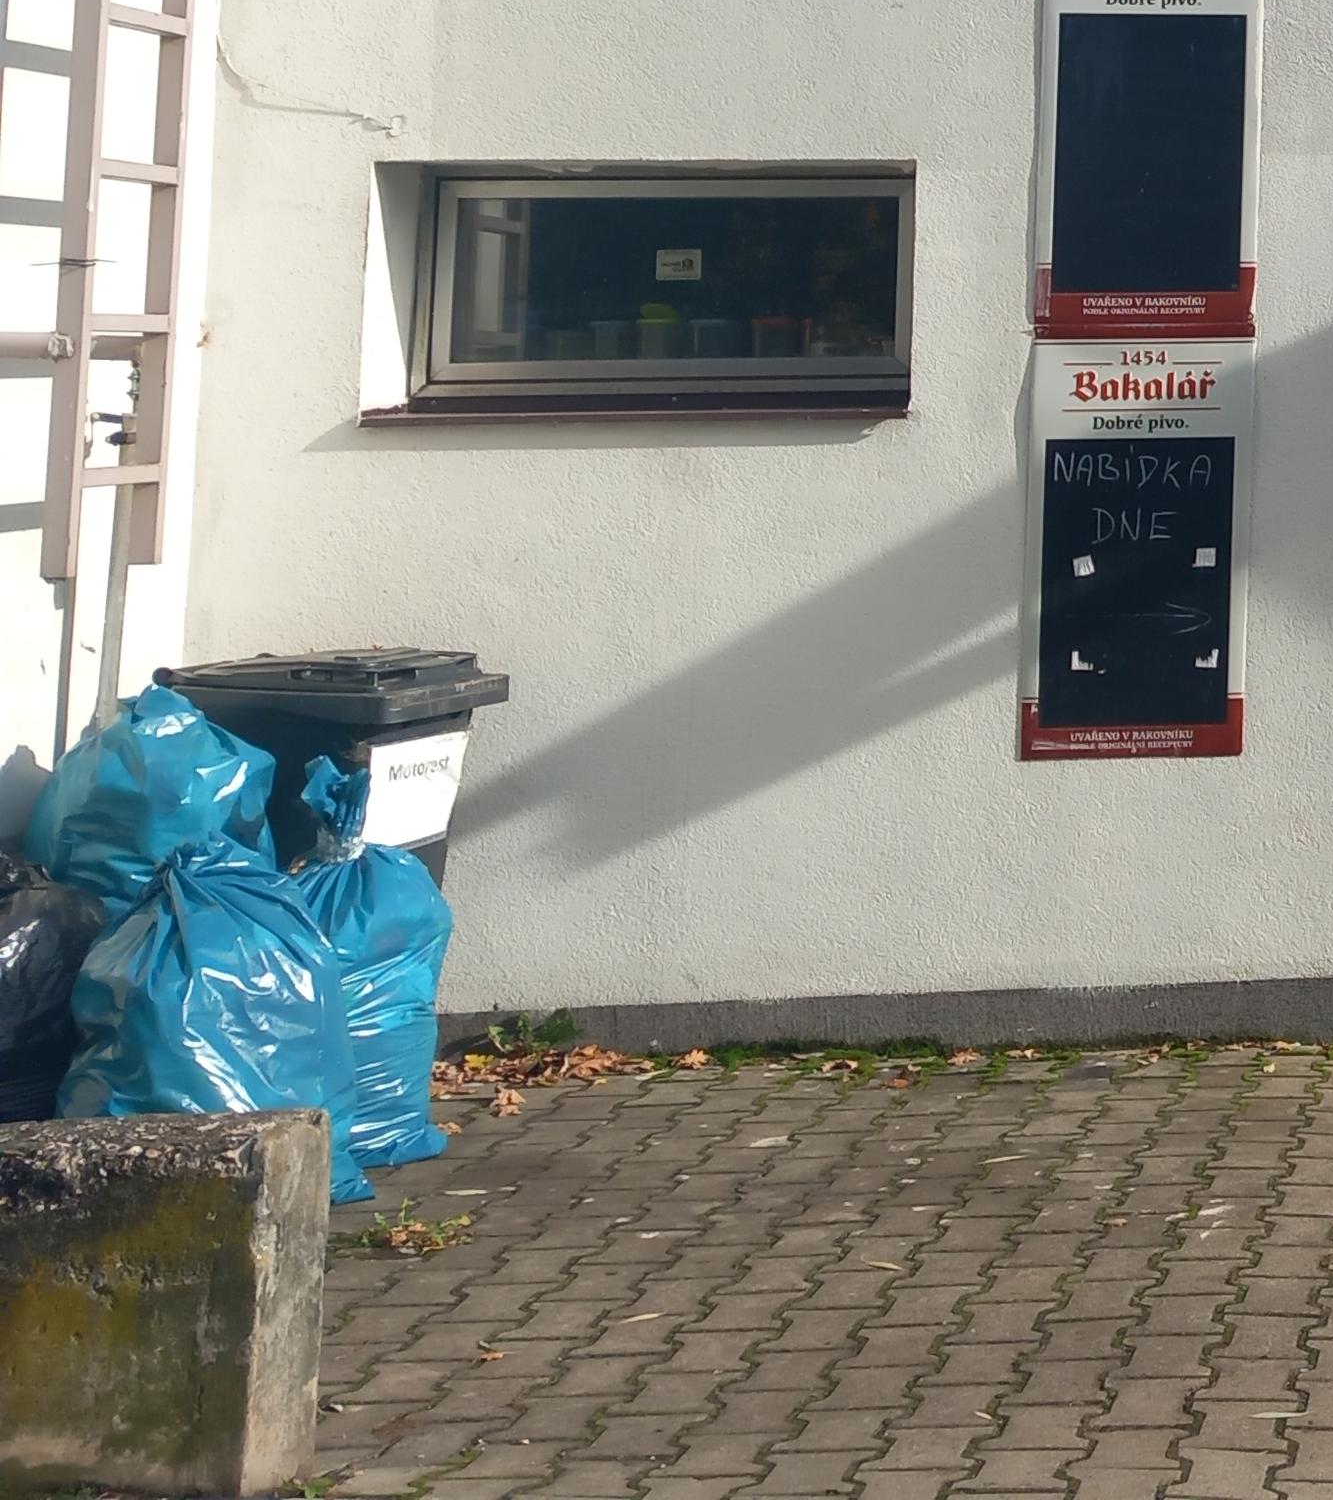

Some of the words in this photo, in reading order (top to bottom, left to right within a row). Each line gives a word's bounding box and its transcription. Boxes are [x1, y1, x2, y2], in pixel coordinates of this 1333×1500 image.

[1120, 350, 1167, 366] 1454
[1069, 370, 1217, 403] Bakalář
[1092, 414, 1144, 430] Dobré
[1148, 415, 1190, 433] pivo.
[1052, 444, 1213, 491] NABÍDKA
[1091, 507, 1177, 545] DNE
[388, 755, 451, 782] Motorest
